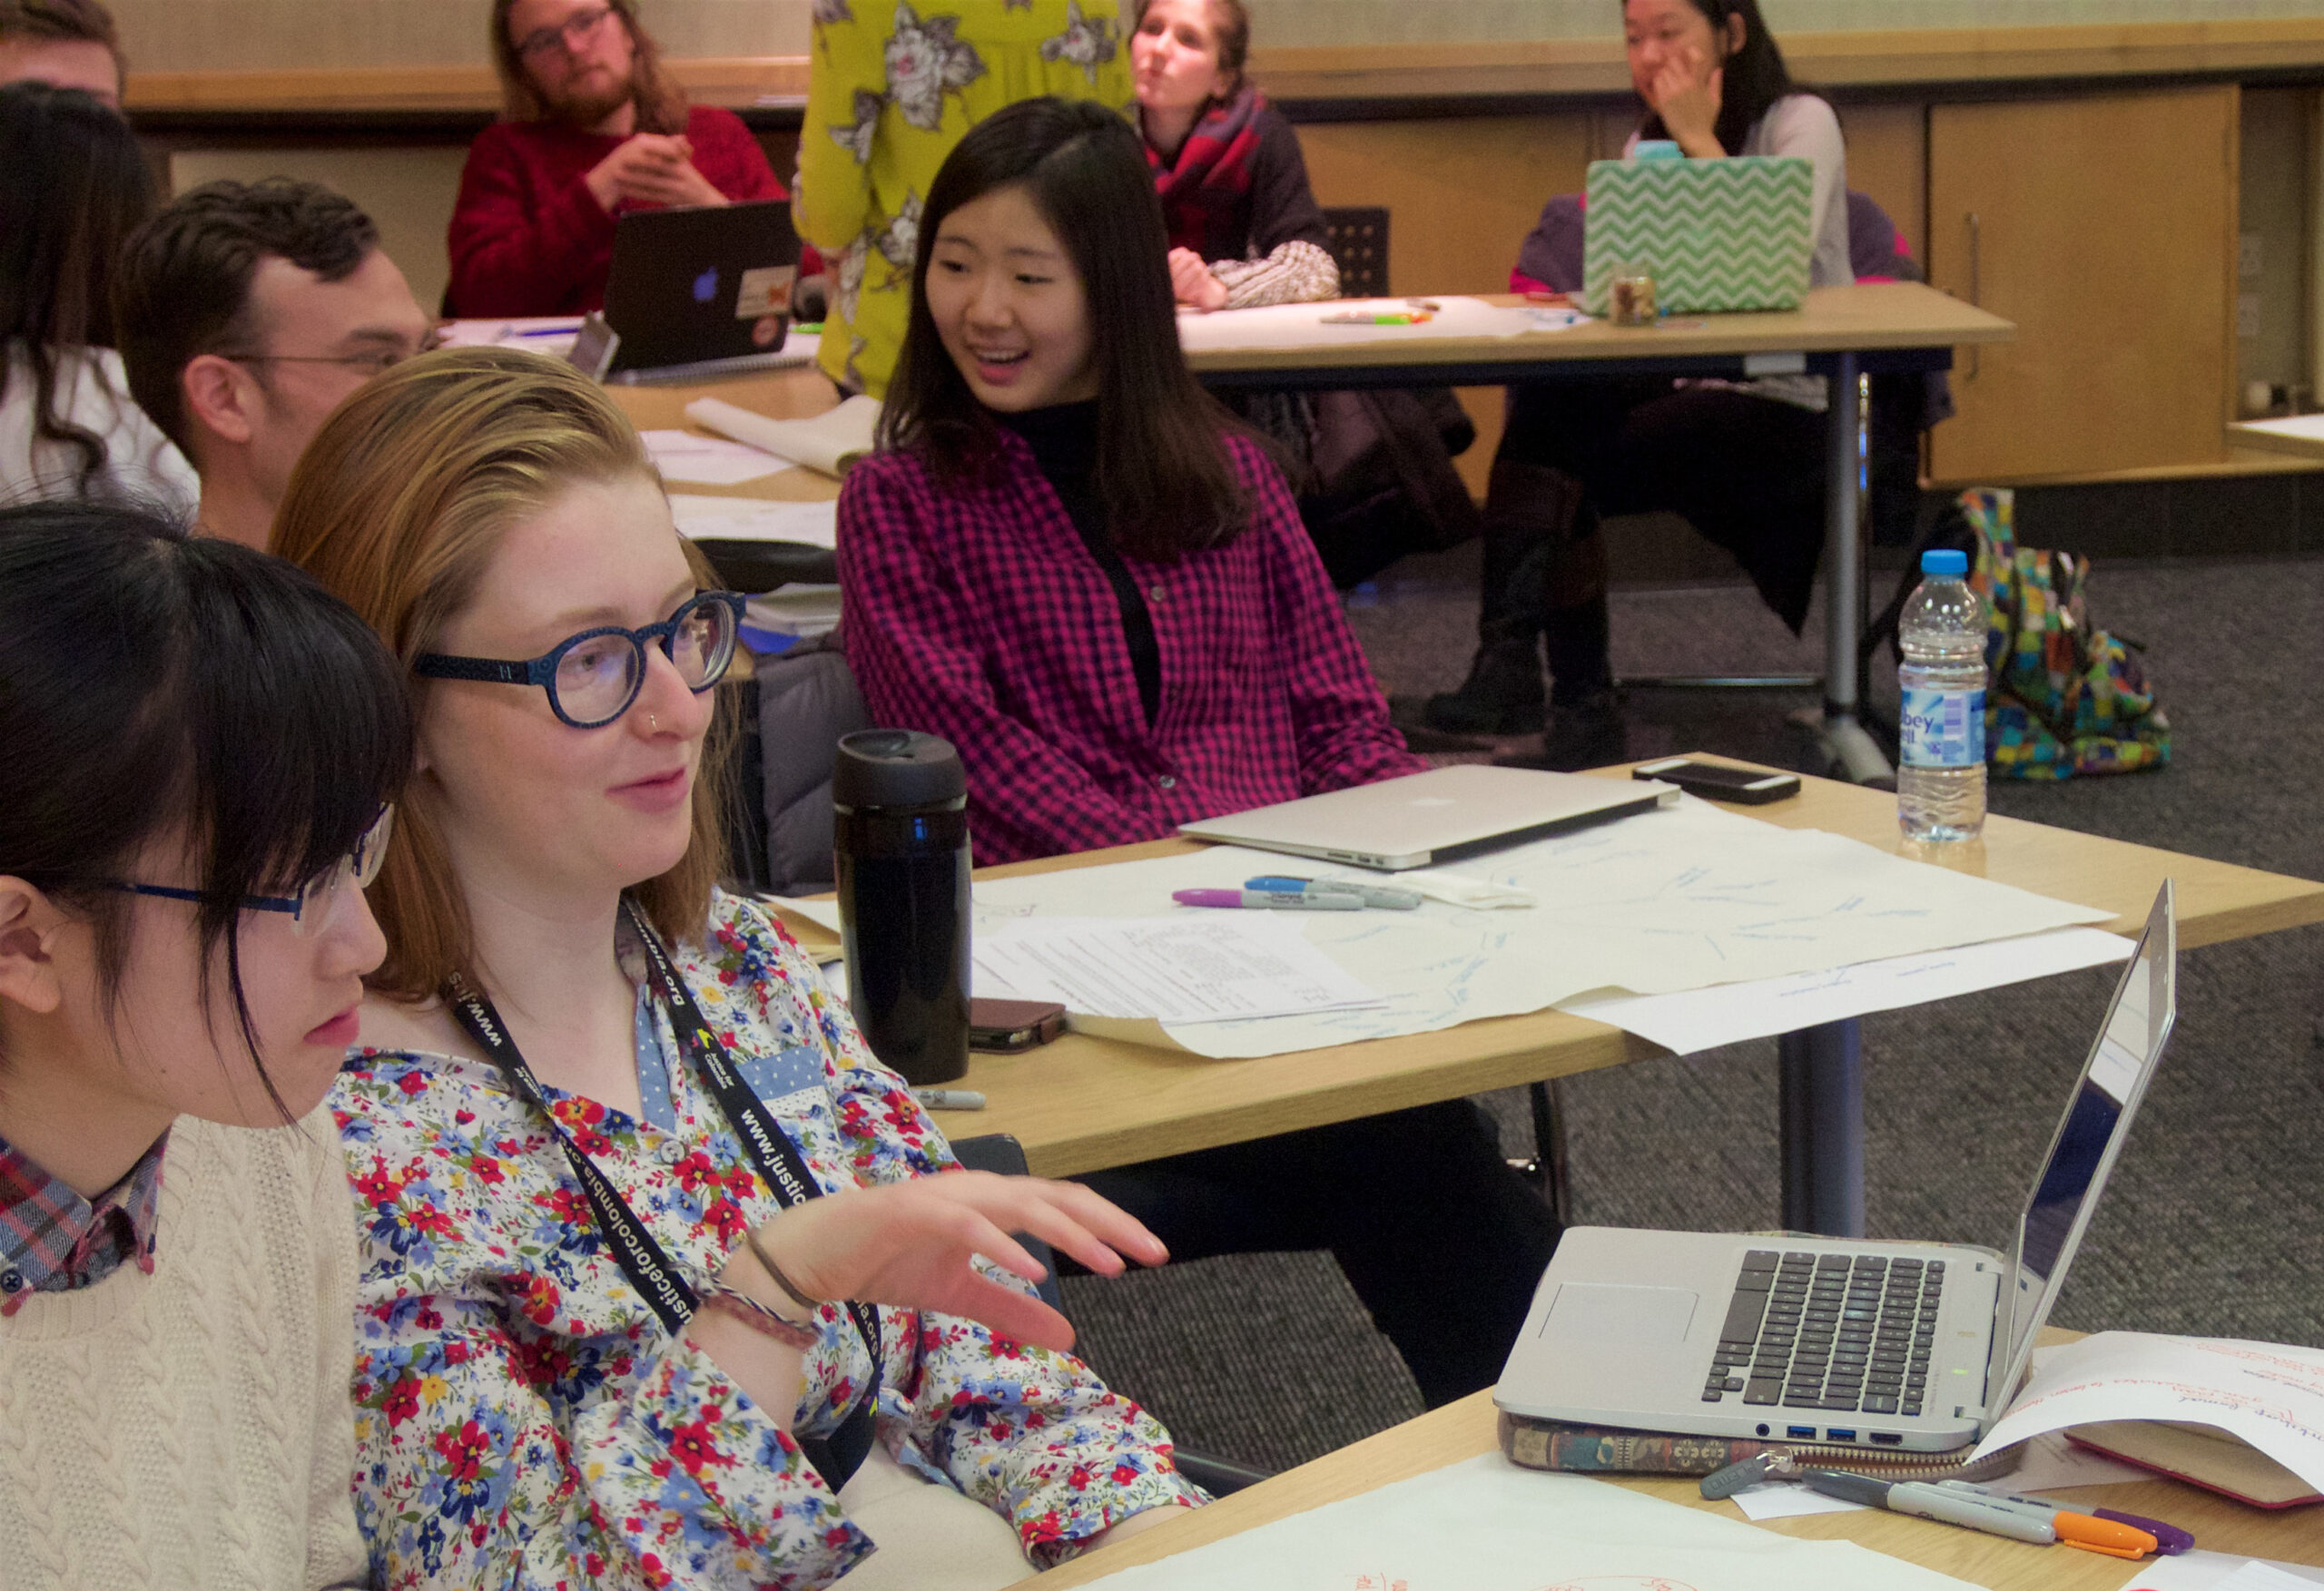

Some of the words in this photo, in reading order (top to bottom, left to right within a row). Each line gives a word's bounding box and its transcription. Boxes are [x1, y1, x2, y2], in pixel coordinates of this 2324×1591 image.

[1900, 706, 1934, 733] bey
[704, 1053, 728, 1089] Colombia
[710, 1052, 727, 1076] Justice
[724, 1075, 735, 1087] for
[740, 1108, 806, 1205] www.justic
